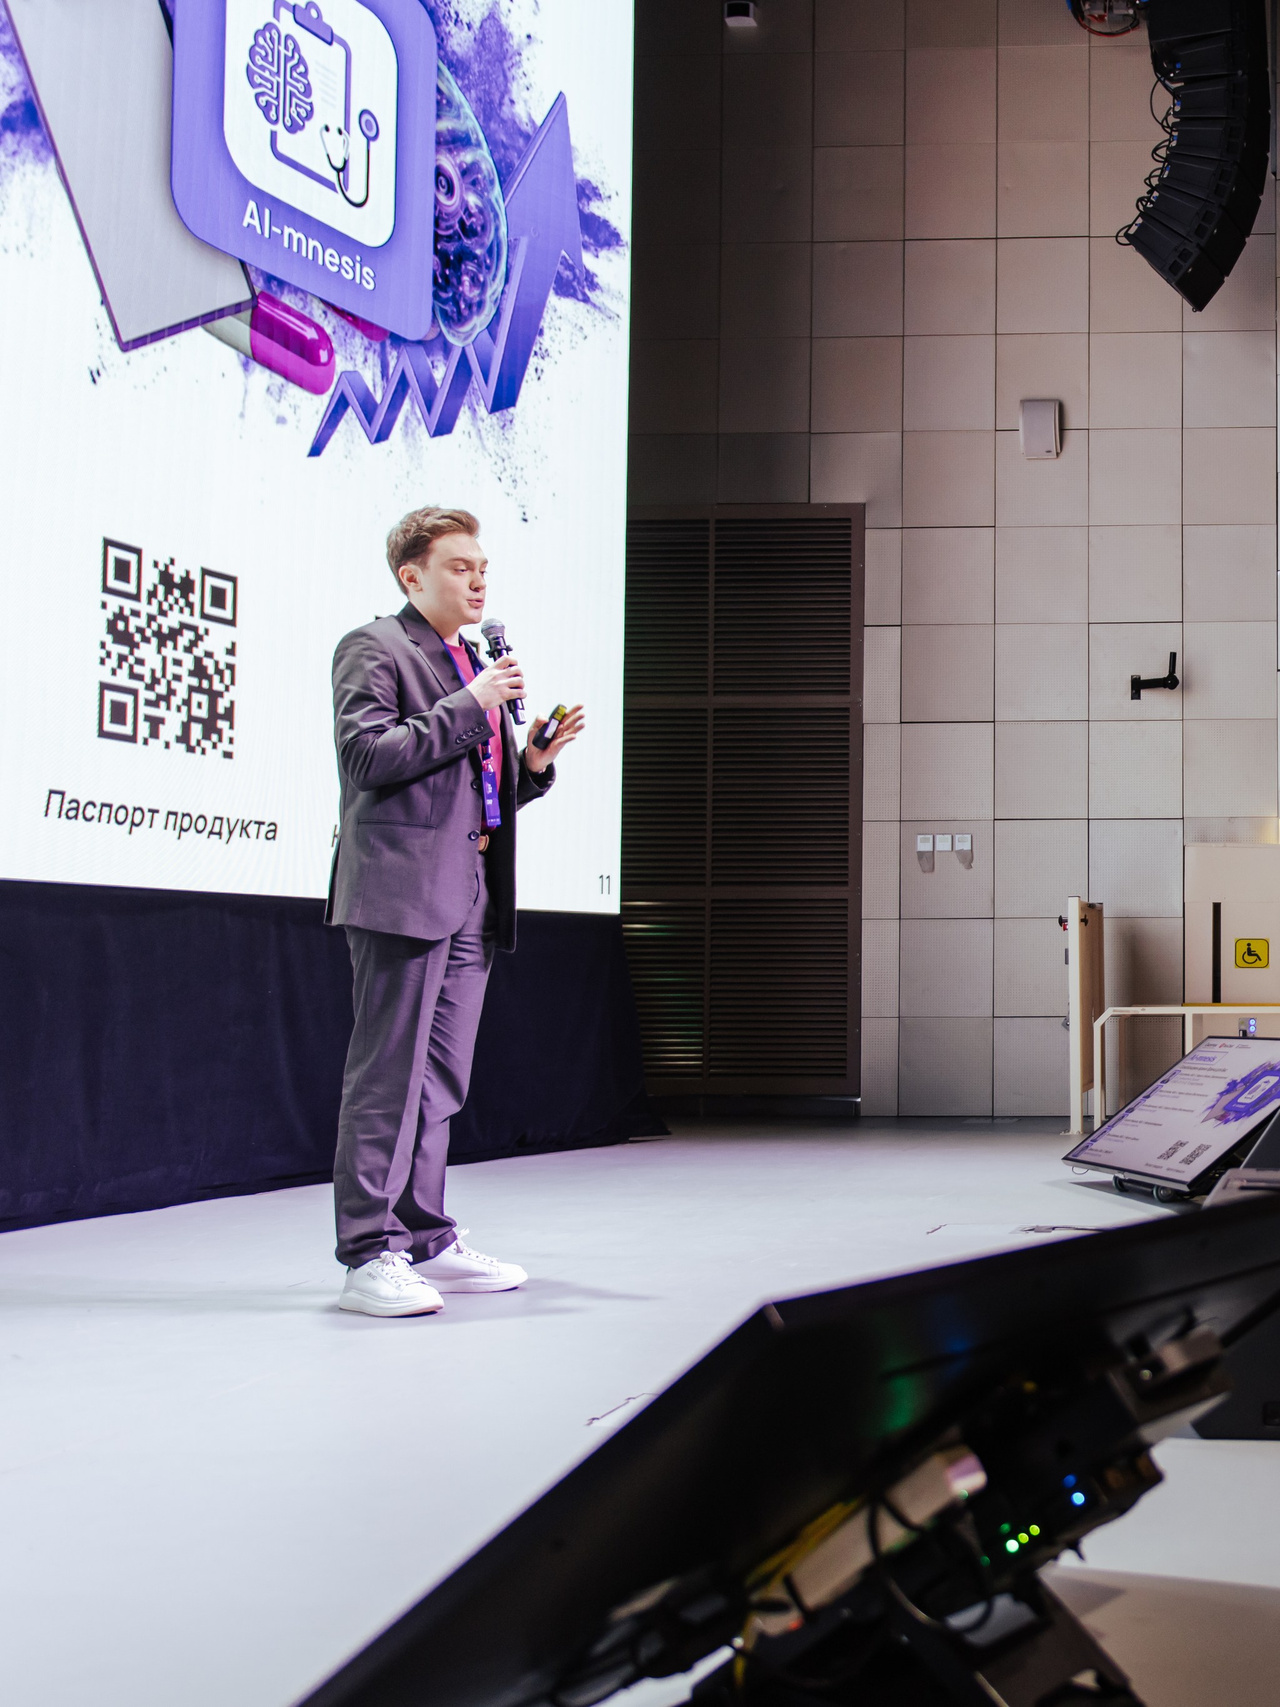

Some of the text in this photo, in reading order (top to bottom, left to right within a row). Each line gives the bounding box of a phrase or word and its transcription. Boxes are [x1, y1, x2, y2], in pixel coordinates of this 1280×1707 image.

[242, 199, 377, 291] AI-mnesis
[44, 788, 279, 845] Паспорт продукта
[599, 874, 611, 895] 11
